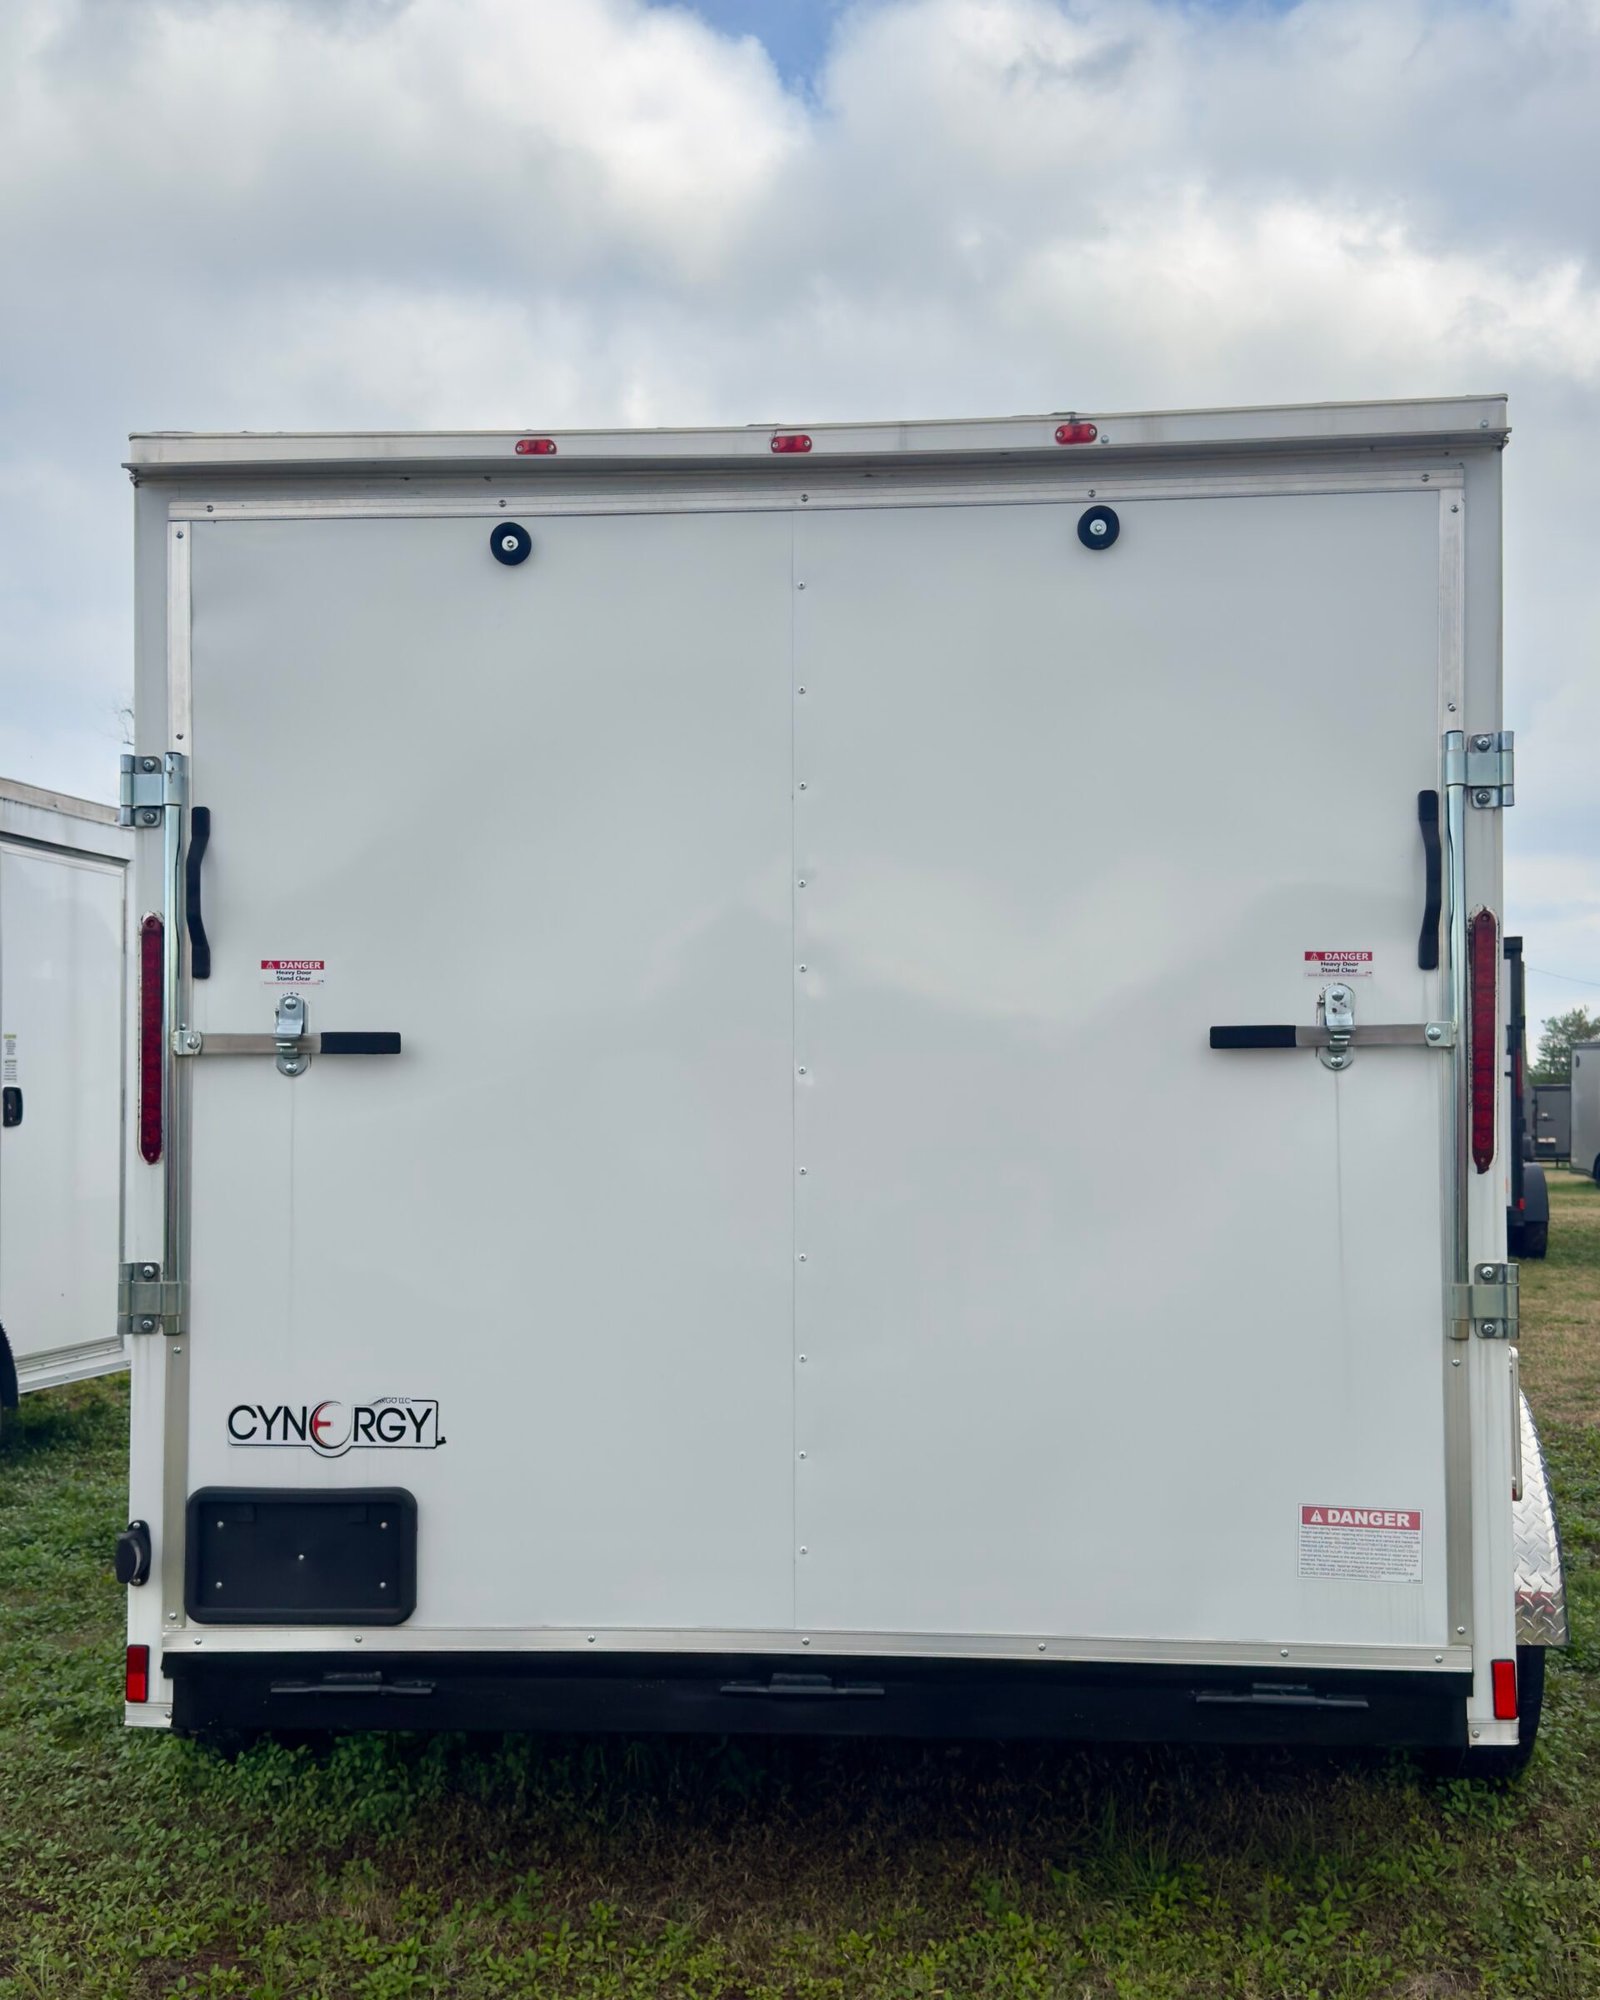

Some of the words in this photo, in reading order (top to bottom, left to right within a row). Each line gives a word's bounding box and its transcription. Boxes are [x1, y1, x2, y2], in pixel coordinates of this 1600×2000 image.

[1324, 952, 1369, 960] DANGER
[280, 961, 321, 969] DANGER
[228, 1401, 433, 1449] CYNERGY
[1327, 1509, 1410, 1527] DANGER
